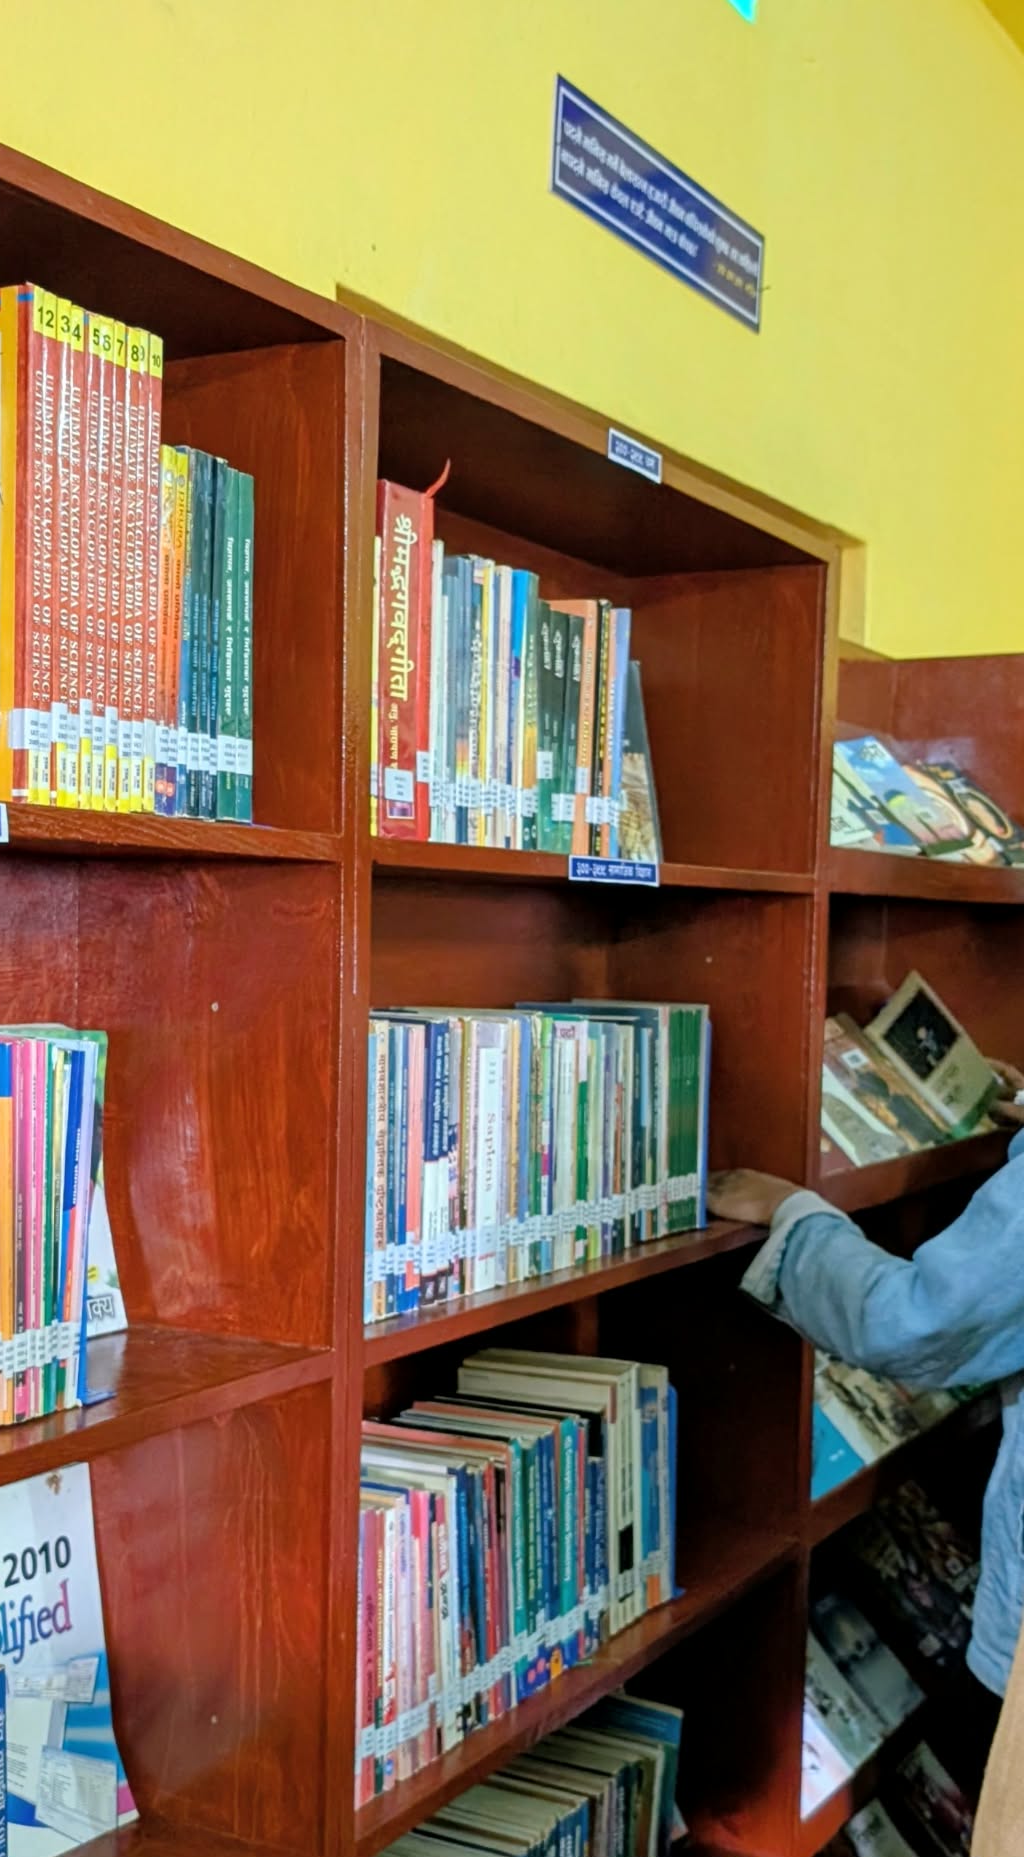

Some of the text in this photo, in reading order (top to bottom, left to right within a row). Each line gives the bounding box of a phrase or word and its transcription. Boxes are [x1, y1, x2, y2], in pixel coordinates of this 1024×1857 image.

[33, 370, 42, 450] ULTIMATE
[42, 374, 54, 454] ULTIMATE
[70, 386, 80, 466] ULTIMATE
[128, 406, 136, 482] ULTIMATE
[150, 411, 160, 487] ULTIMATE
[32, 458, 42, 596] ENCYCLOPAEDIA
[42, 462, 54, 600] ENCYCLOPAEDIA
[68, 474, 80, 608] ENCYCLOPAEDIA
[96, 480, 110, 614] ENCYCLOPAEDIA
[124, 489, 136, 620] ENCYCLOPAEDIA
[147, 494, 160, 621] ENCYCLOPAEDIA
[32, 604, 41, 626] OF
[41, 606, 52, 628] OF
[68, 614, 79, 635] OF
[95, 618, 106, 640] OF
[124, 625, 134, 646] OF
[147, 626, 157, 646] OF
[482, 1112, 497, 1192] Sapiens
[2, 1535, 72, 1588] 2010
